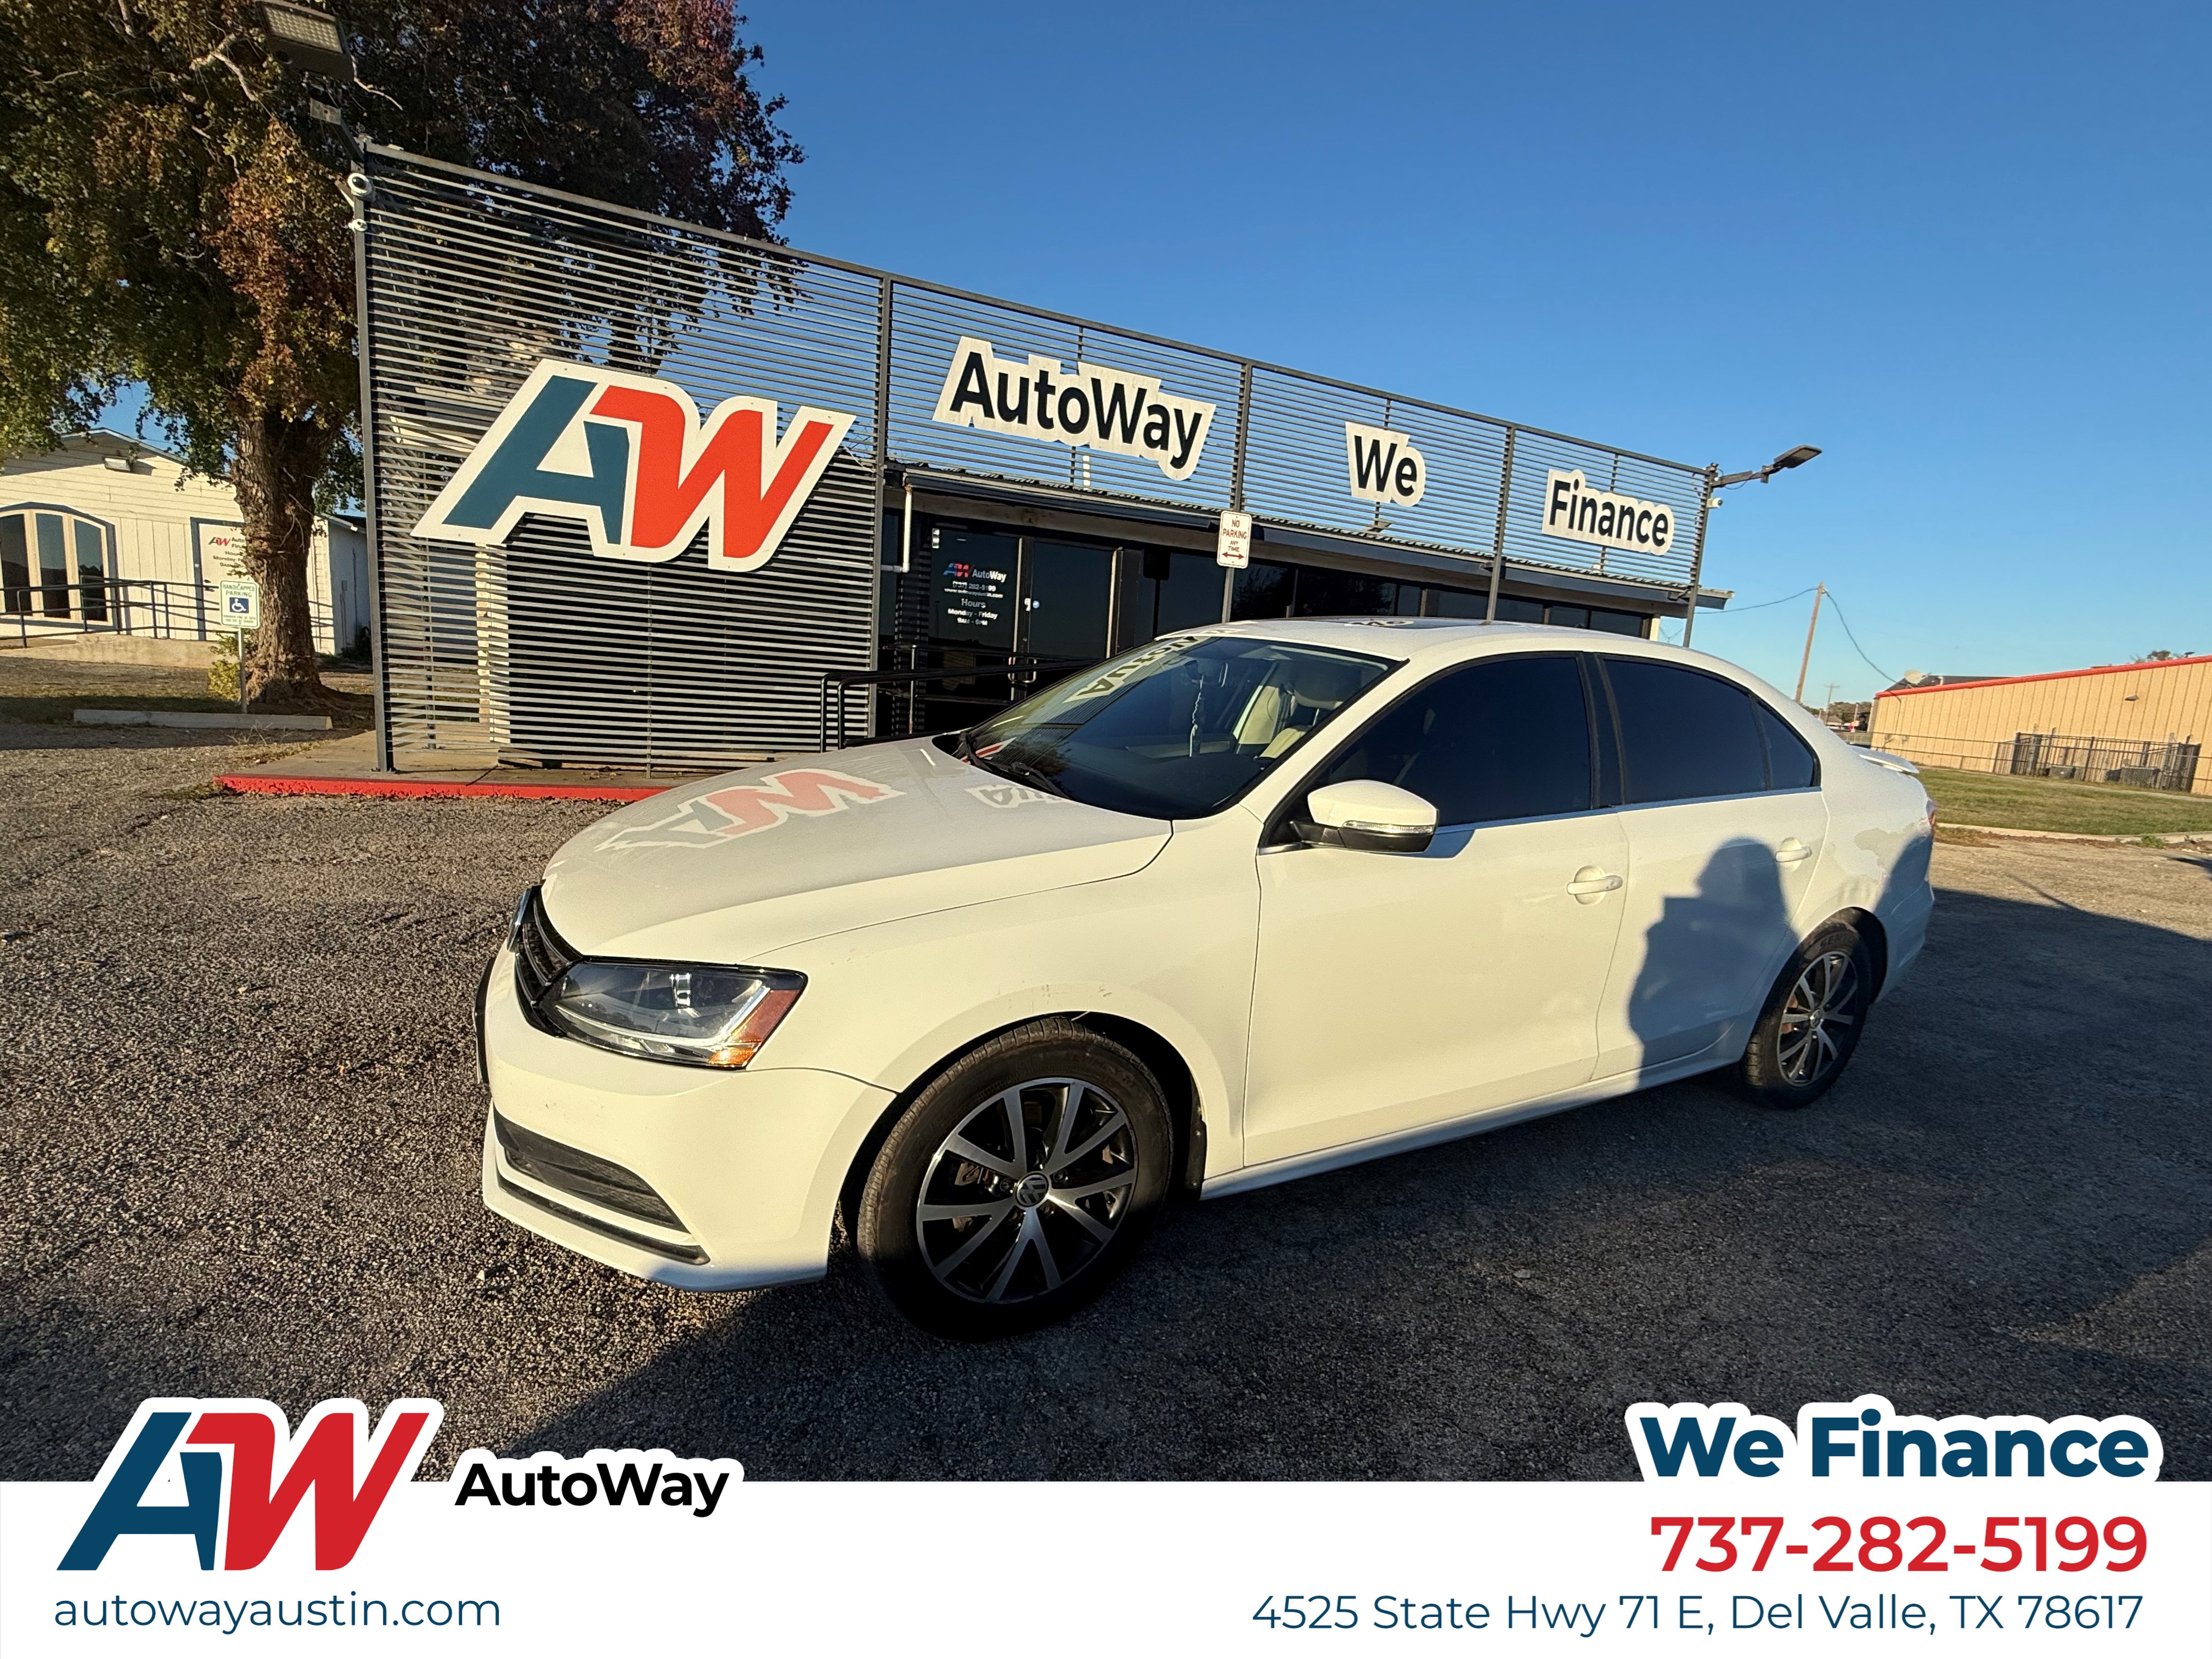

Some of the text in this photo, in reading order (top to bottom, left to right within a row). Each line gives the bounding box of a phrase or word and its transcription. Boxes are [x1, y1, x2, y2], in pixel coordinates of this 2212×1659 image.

[950, 351, 1203, 470] AutoWay
[441, 374, 834, 558] AW
[1354, 436, 1417, 495] We
[1549, 478, 1669, 548] Finance
[1232, 519, 1240, 528] NO
[1222, 528, 1247, 539] PARKING
[208, 537, 231, 546] AW
[972, 569, 1007, 583] AutoWay
[223, 584, 255, 592] HANDICAPPED
[961, 598, 986, 608] Hours
[947, 608, 973, 618] Monday
[979, 611, 998, 620] Friday
